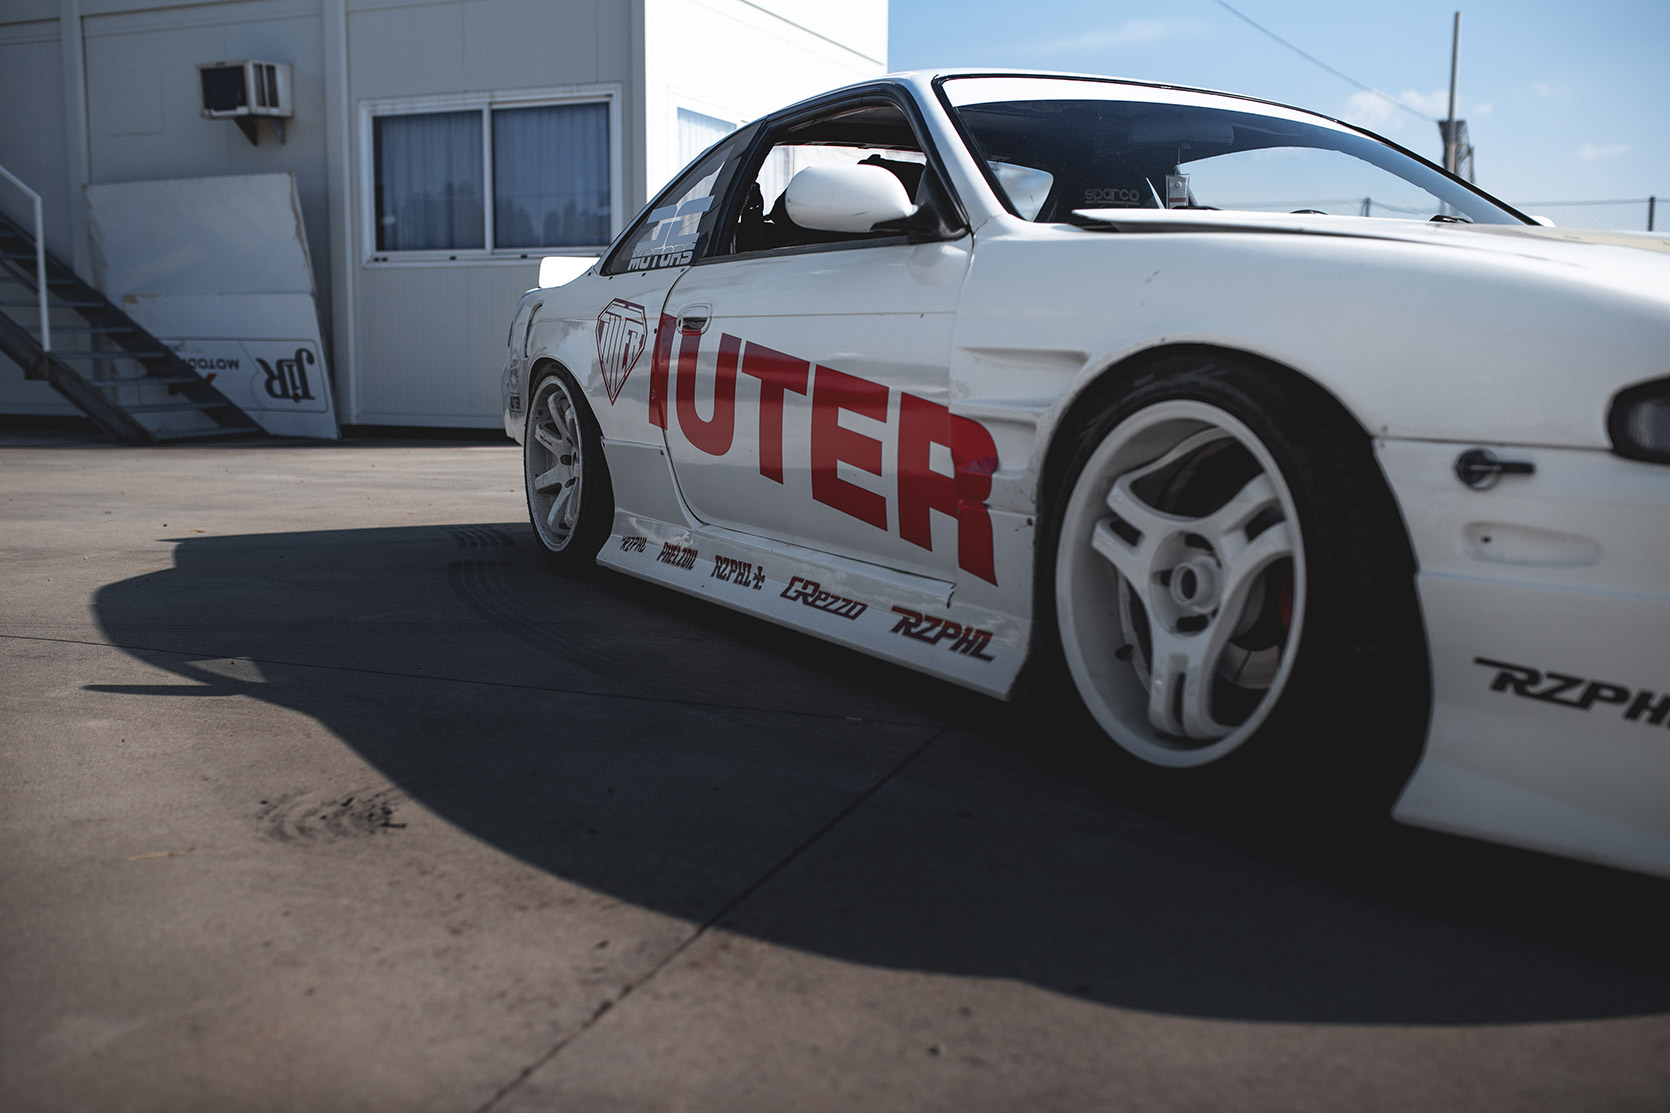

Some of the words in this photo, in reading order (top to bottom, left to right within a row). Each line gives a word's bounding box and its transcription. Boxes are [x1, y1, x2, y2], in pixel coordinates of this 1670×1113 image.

[1084, 188, 1140, 204] sparco
[181, 358, 240, 371] MOTOD
[649, 312, 999, 587] IUTER
[889, 605, 996, 662] RZPHL
[1472, 656, 1670, 729] RZPH
